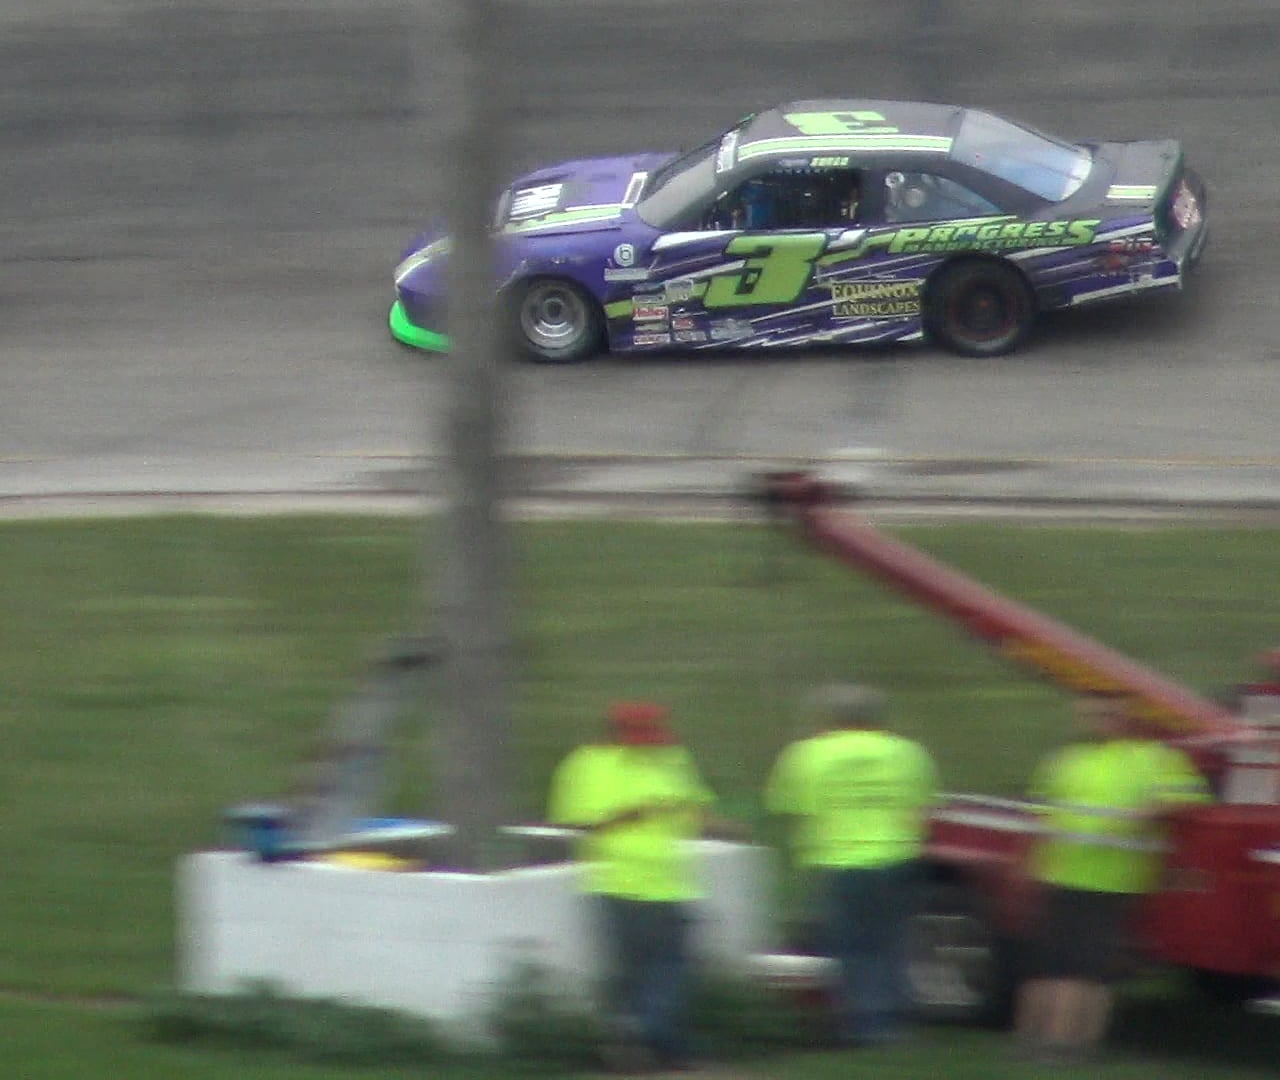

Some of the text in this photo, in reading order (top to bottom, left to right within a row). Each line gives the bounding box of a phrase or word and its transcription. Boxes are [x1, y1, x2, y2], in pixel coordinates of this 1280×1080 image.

[888, 219, 1101, 254] PROGRESS
[702, 232, 828, 310] 3
[832, 301, 920, 316] LANDSCAPES
